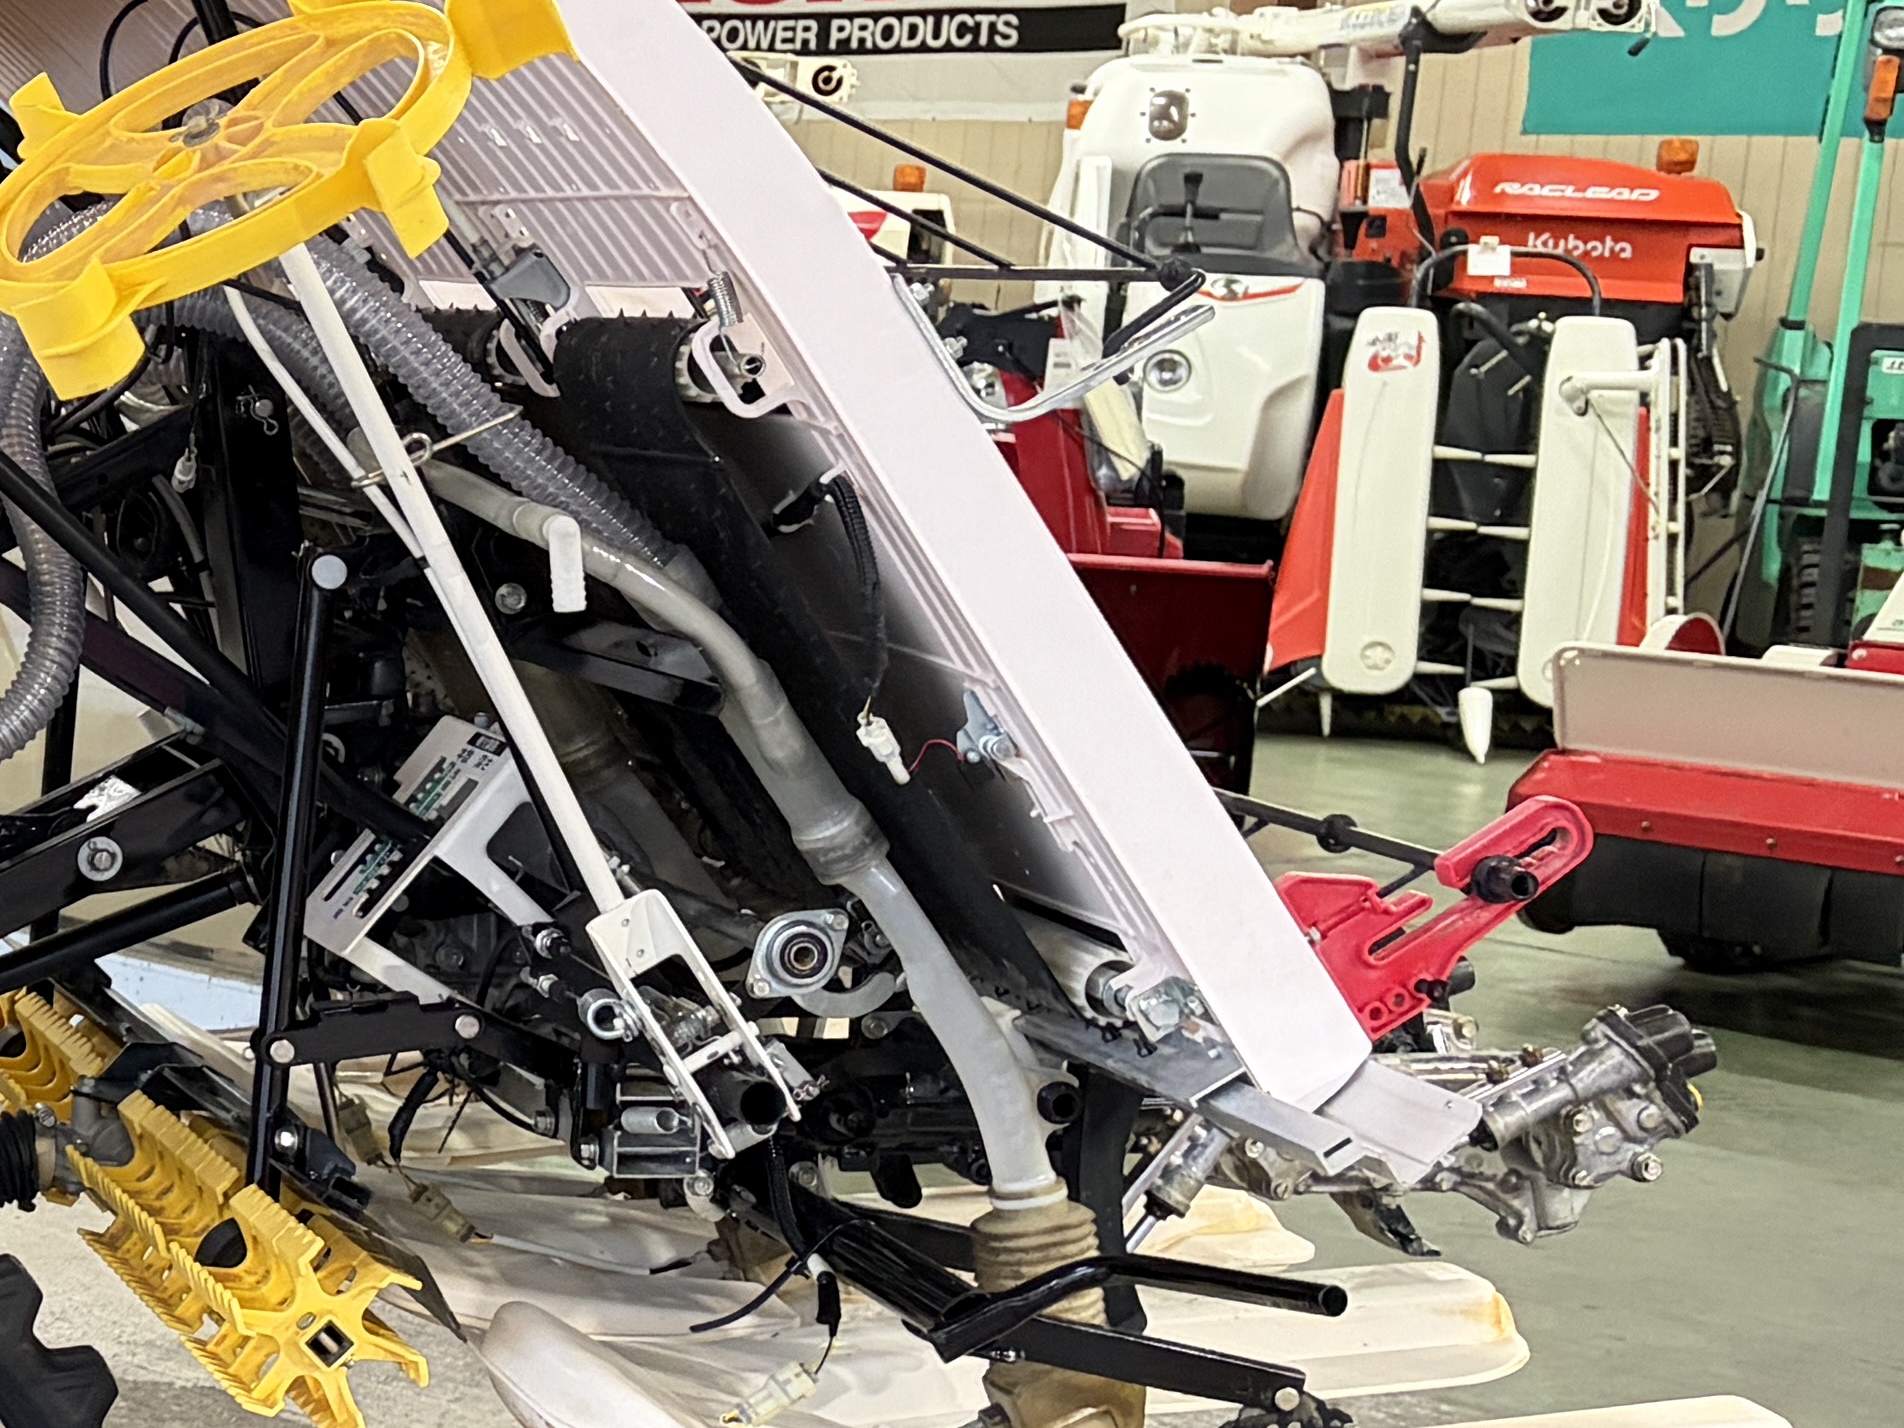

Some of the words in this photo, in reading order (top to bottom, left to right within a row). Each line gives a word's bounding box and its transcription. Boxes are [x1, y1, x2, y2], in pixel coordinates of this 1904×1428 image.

[702, 17, 817, 52] POWER
[829, 13, 1020, 50] PRODUCTS
[1527, 231, 1633, 259] Kubota
